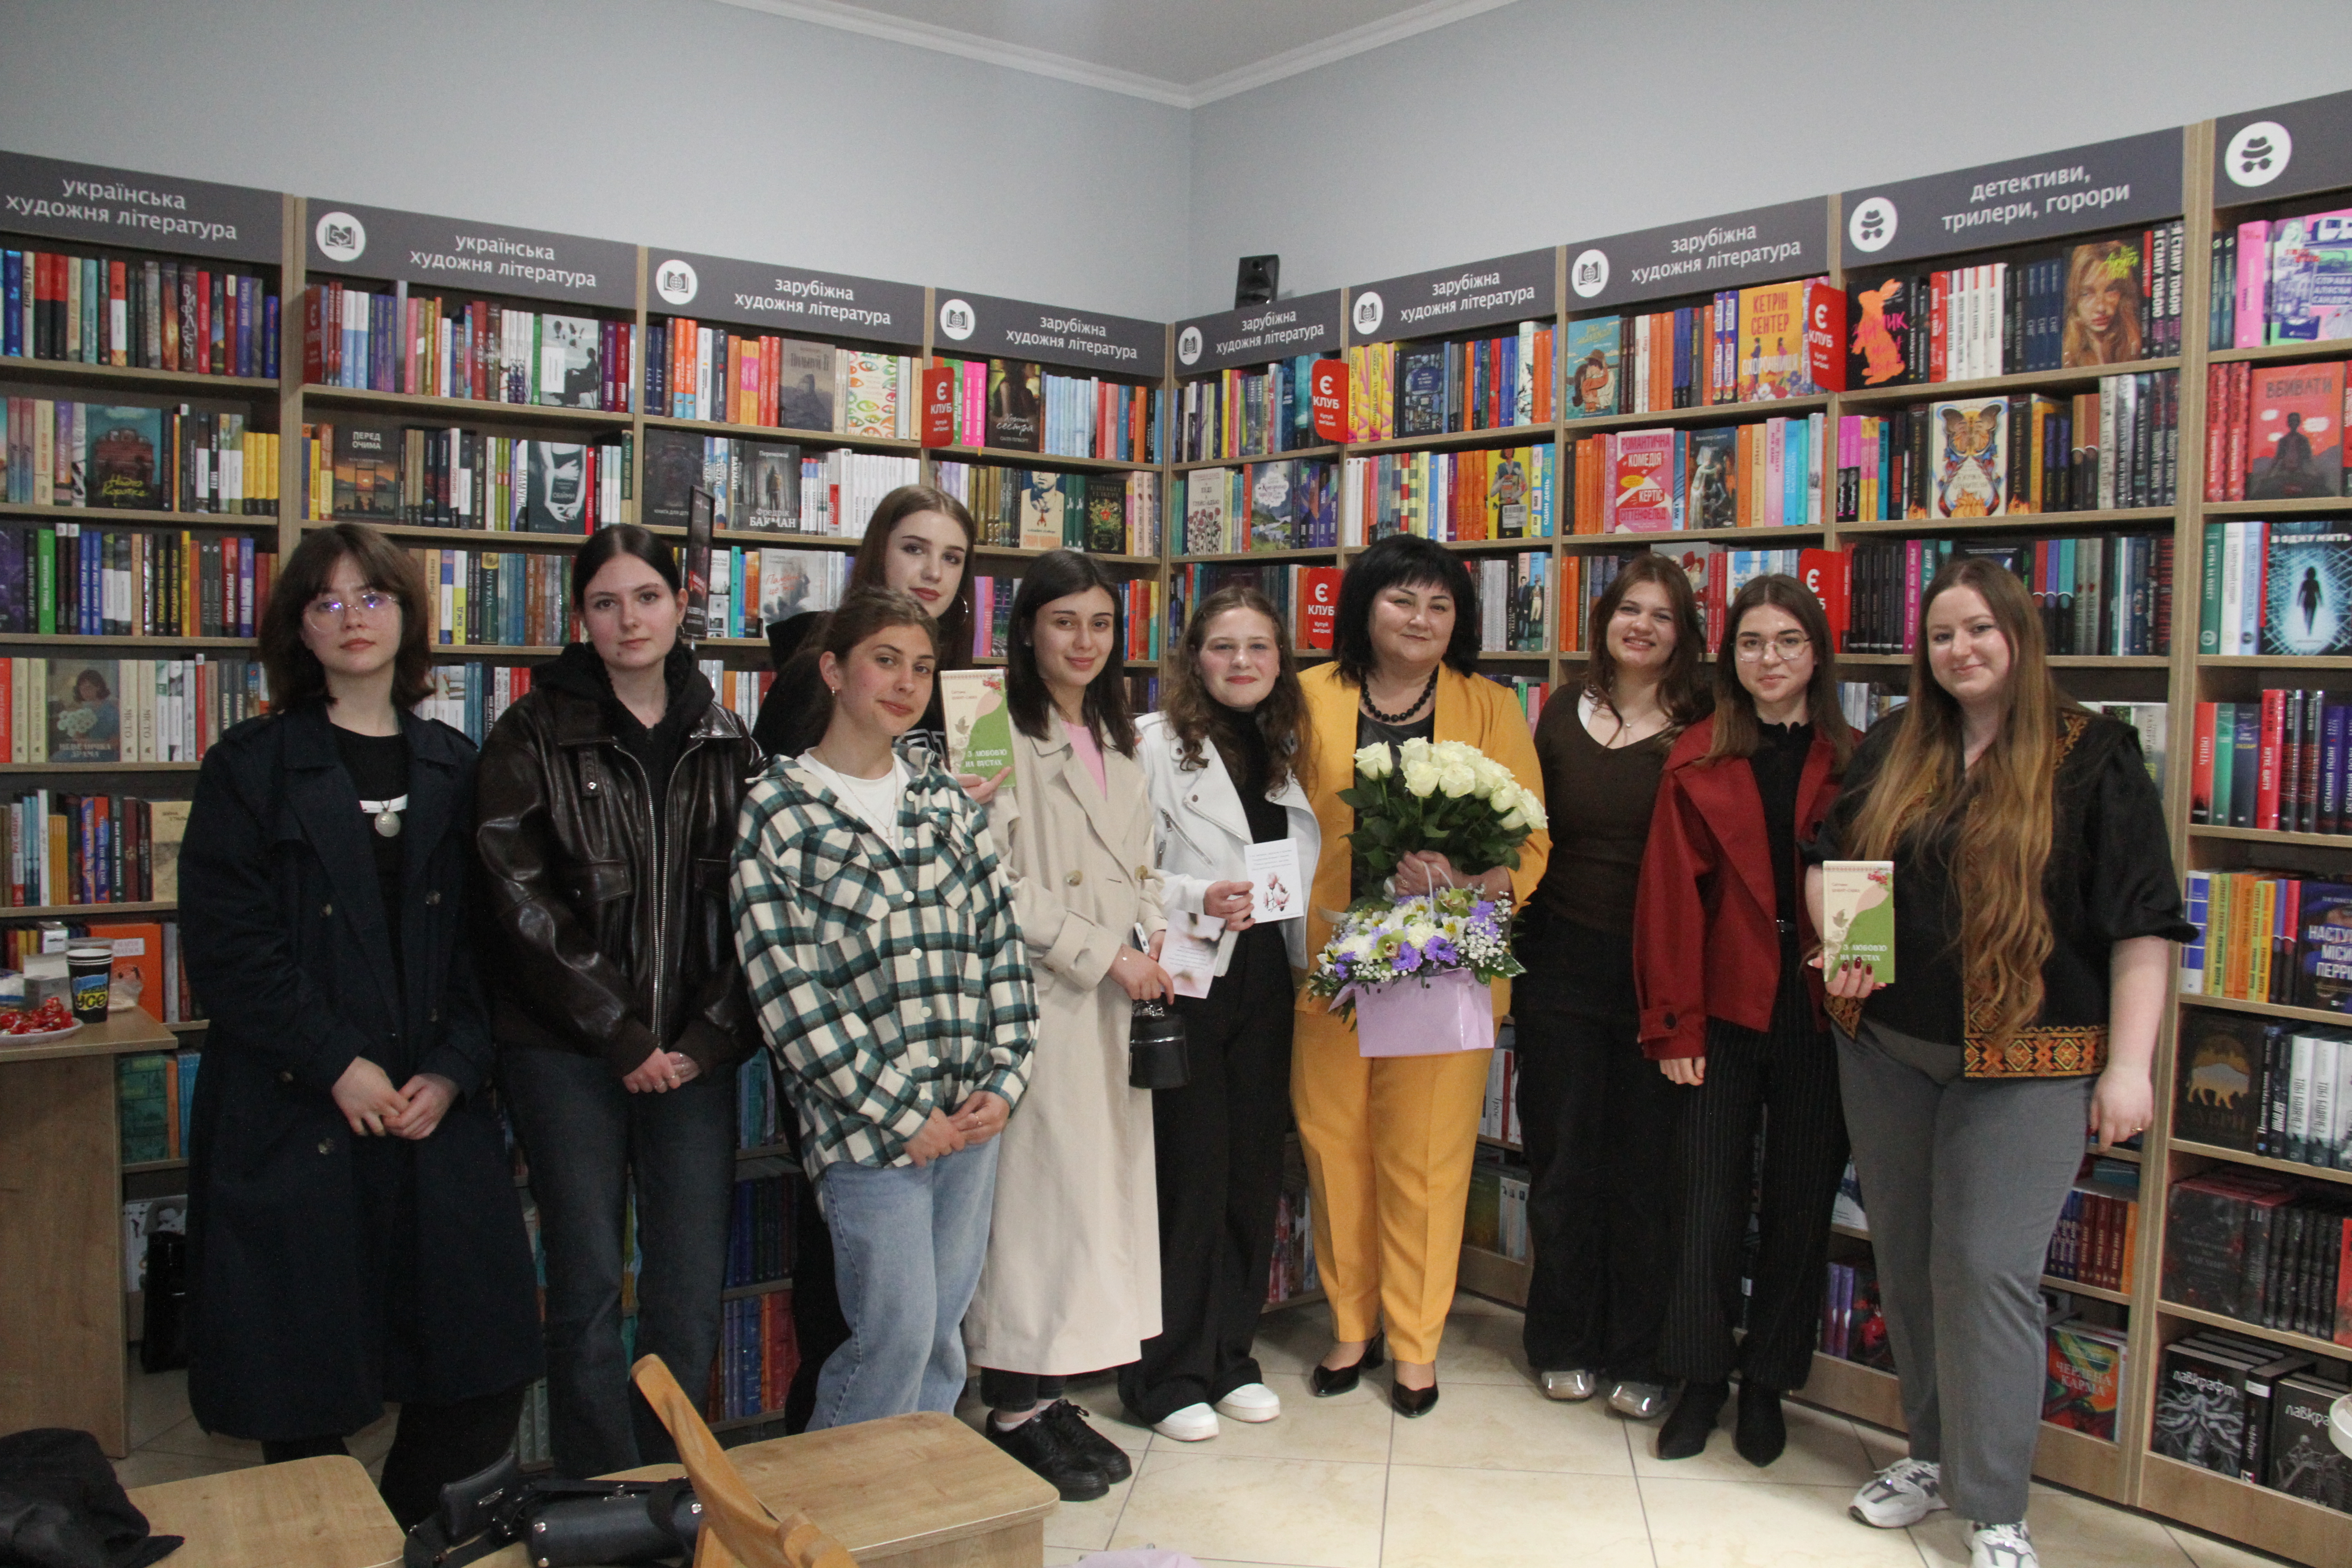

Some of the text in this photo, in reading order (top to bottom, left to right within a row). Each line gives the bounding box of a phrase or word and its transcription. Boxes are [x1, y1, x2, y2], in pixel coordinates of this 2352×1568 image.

[63, 180, 186, 210] українська
[1970, 165, 2092, 203] детективи,
[5, 195, 237, 241] художня література
[1941, 184, 2130, 233] трилери, горори
[455, 235, 555, 261] українська
[1671, 225, 1757, 254] зарубіжна
[1631, 240, 1802, 284] художня література
[2153, 239, 2165, 274] СТАНУ
[2170, 236, 2183, 272] СТАНУ
[410, 250, 597, 288] художня література
[774, 277, 854, 301] зарубіжна
[1432, 272, 1500, 296] зарубіжна
[2169, 274, 2182, 315] ТОБОЮ
[734, 292, 892, 326] художня література
[1400, 286, 1535, 323] художня література
[1753, 291, 1788, 314] КЕТРІН
[2152, 276, 2165, 318] ТОБОЮ
[1039, 316, 1106, 337] зарубіжна
[1241, 310, 1297, 332] зарубіжна
[1750, 314, 1789, 336] СЕНТЕР
[1814, 303, 1828, 329] Є
[1005, 329, 1137, 360] художня література
[1216, 323, 1324, 354] художня література
[1808, 330, 1833, 348] КЛУБ
[936, 382, 947, 401] Є
[1319, 375, 1333, 395] Є
[931, 403, 952, 414] КЛУБ
[1313, 396, 1340, 410] КЛУБ
[352, 440, 382, 451] ОЧИМА
[353, 431, 381, 441] ПЕРЕД
[1621, 433, 1671, 451] РОМАНТИЧНА
[1627, 451, 1662, 467] КОМЕДІЯ
[516, 469, 526, 508] МАМУСЯ
[1638, 489, 1663, 502] КЕРТІС
[756, 508, 790, 517] Фредрік
[2280, 534, 2315, 544] ОДНУ
[2316, 533, 2352, 542] МИТЬ
[485, 569, 494, 608] ЧУЖА ГРА
[1806, 568, 1820, 593] Є
[1315, 583, 1328, 603] Є
[456, 606, 465, 629] БЖД
[1308, 605, 1335, 617] КЛУБ
[2199, 736, 2209, 765] ЧТИВО
[976, 760, 1003, 769] ВУСТАХ
[2262, 769, 2271, 790] ЩАСТЯ
[2323, 746, 2337, 812] ОСТАННІЙ ПОЛІТ
[2321, 944, 2352, 962] МІСИ
[2316, 961, 2352, 980] ПЕРРІ
[2271, 1101, 2287, 1132] БОГОМОЛ
[2061, 1374, 2106, 1397] КАРМА
[2285, 1404, 2330, 1429] лавкра
